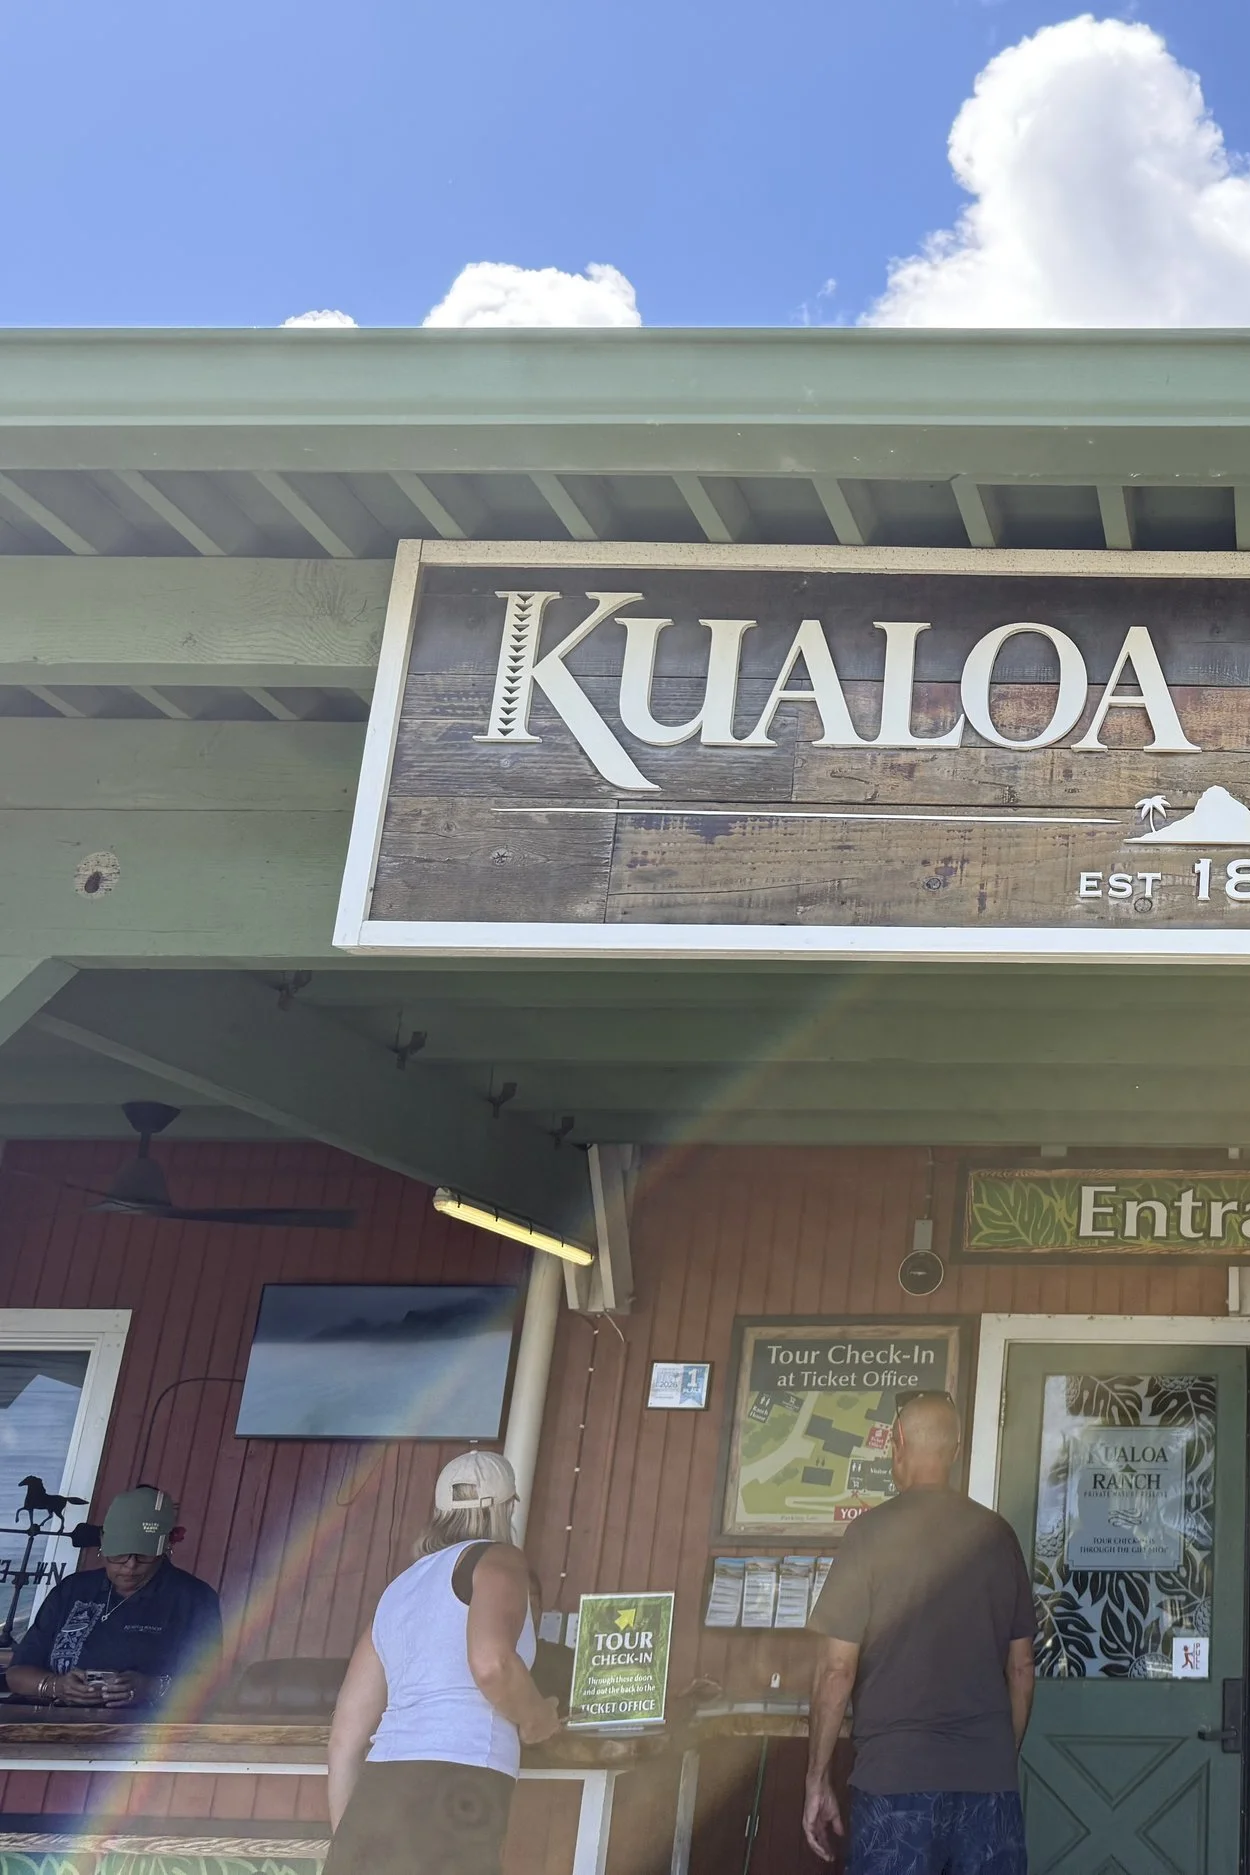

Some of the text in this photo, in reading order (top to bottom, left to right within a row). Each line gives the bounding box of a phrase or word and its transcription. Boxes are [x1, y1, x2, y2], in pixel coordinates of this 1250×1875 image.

[472, 590, 1202, 792] KUALOA
[1080, 871, 1162, 900] EST
[767, 1344, 935, 1364] Tour Check-In
[777, 1371, 918, 1386] at Ticket Office
[1092, 1473, 1161, 1490] RANCH
[594, 1631, 653, 1651] TOUR
[591, 1652, 653, 1666] CHECK-IN
[588, 1676, 616, 1685] Through
[634, 1674, 652, 1682] doors
[583, 1688, 596, 1696] and
[596, 1686, 608, 1694] out
[608, 1686, 619, 1694] the
[620, 1684, 636, 1694] back
[618, 1700, 656, 1712] OFFICE
